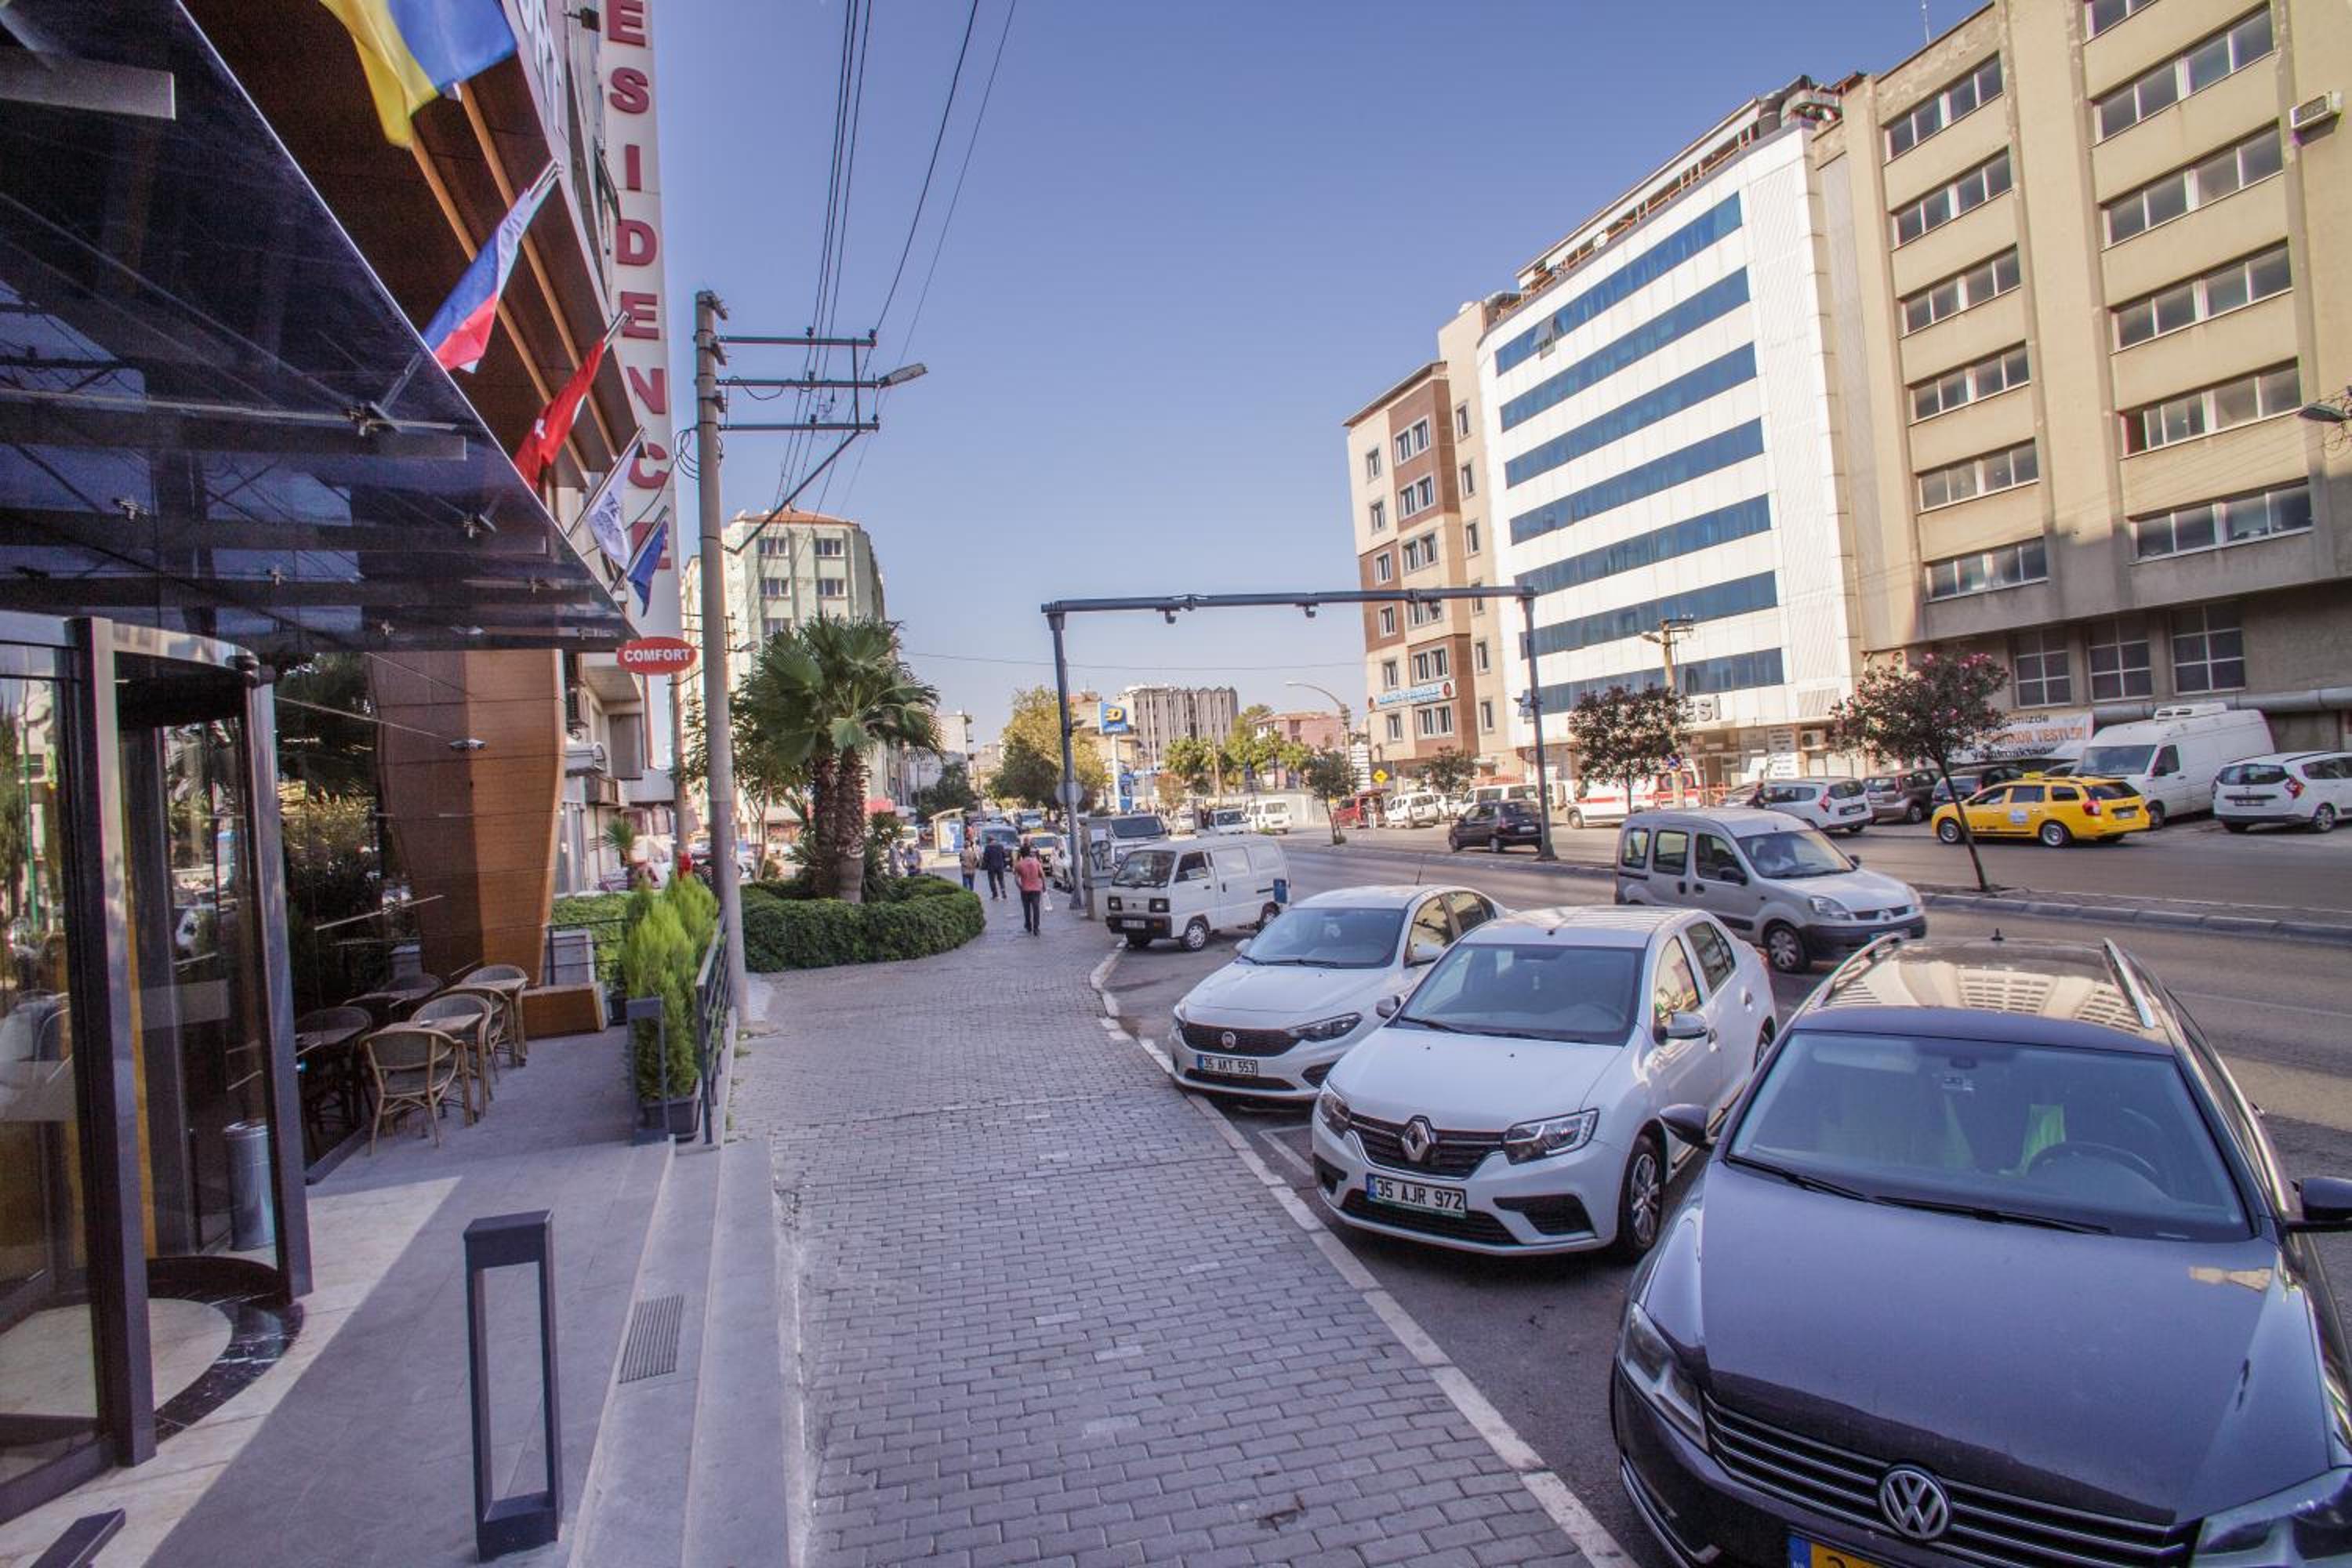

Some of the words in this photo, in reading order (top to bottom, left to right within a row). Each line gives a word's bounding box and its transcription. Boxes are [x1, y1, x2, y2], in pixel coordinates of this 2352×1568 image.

[624, 648, 690, 662] COMFORT
[1377, 1180, 1393, 1199] 35
[1400, 1184, 1426, 1204] AJR
[1434, 1190, 1463, 1210] 972
